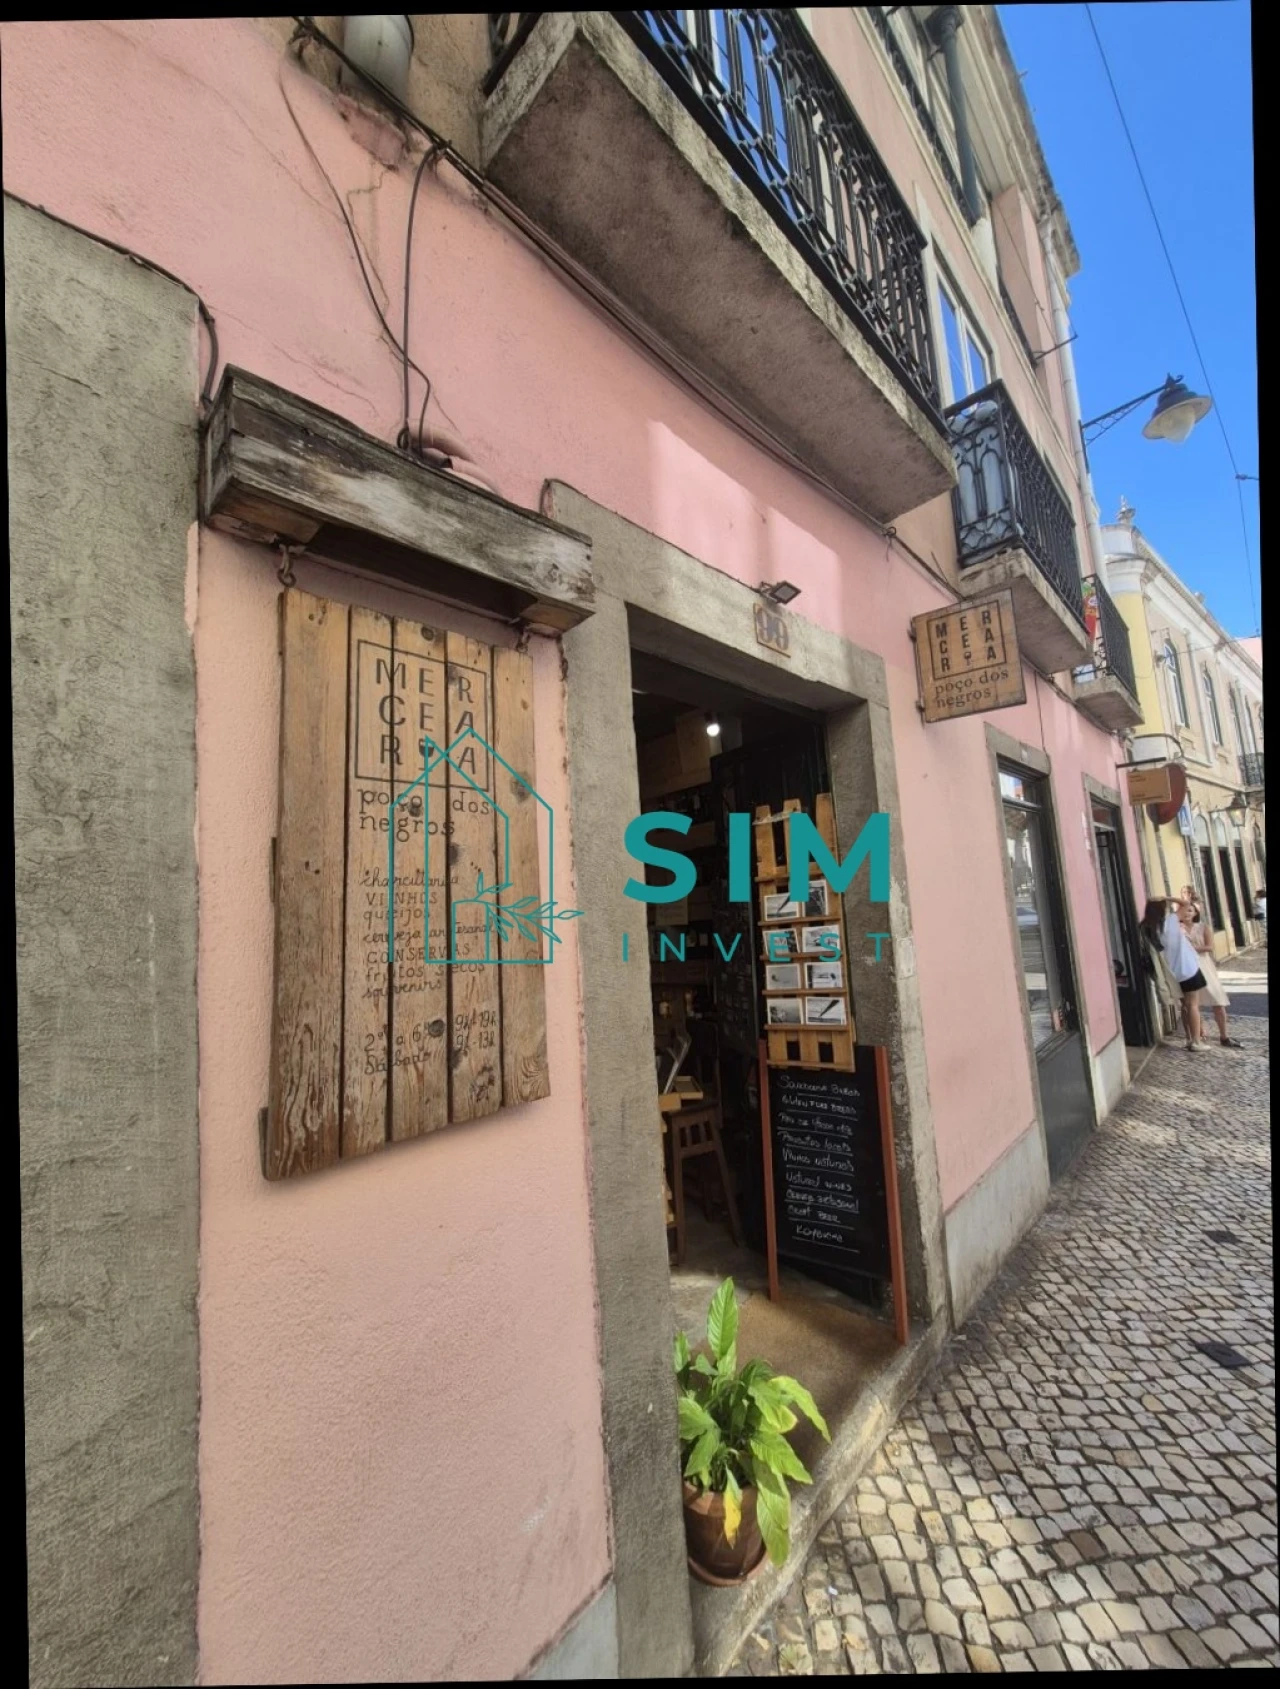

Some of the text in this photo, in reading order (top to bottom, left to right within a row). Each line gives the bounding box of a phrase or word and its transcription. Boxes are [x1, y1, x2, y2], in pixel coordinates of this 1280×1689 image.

[934, 669, 1009, 699] poço dos
[936, 687, 991, 708] negros
[357, 789, 490, 815] poço dos
[359, 815, 455, 842] negros
[366, 891, 438, 906] VINHOS
[363, 928, 420, 948] cerveja
[366, 962, 486, 984] frutos secos
